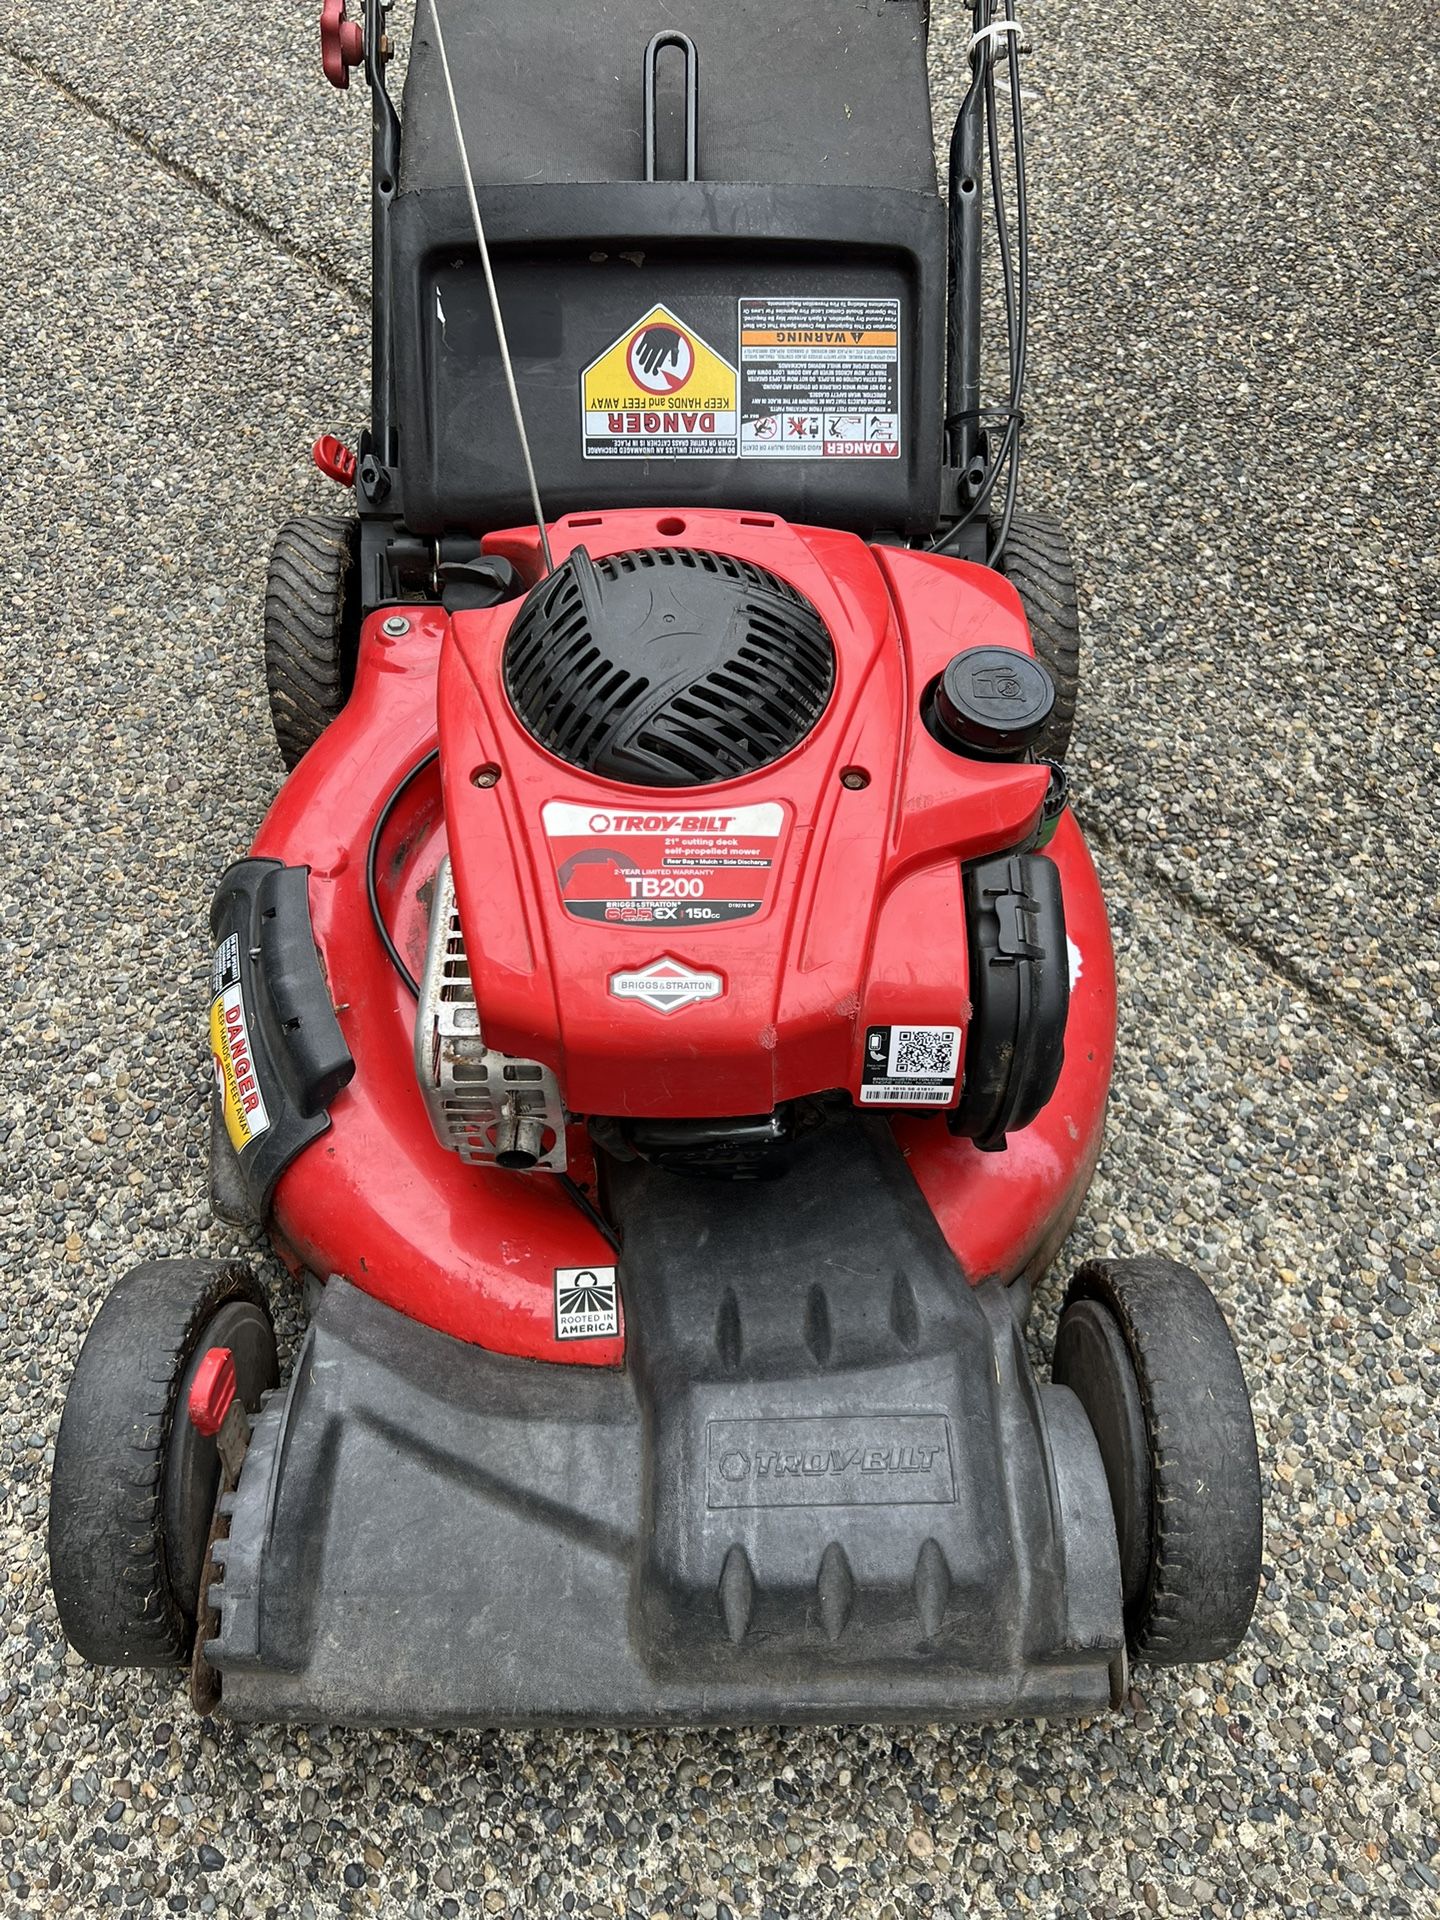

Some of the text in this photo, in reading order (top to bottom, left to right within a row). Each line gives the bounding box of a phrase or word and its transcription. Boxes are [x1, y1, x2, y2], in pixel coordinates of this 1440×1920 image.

[776, 332, 846, 343] WARNING
[591, 397, 729, 409] KEEP HANDS and FEET AWAY
[608, 412, 715, 433] DANGER
[612, 439, 735, 447] COVER OR ENTIRE GRASS CATCHER IS IN PLACE.
[827, 442, 881, 454] DANGER
[612, 816, 733, 832] TROY-BILT
[664, 838, 739, 847] 21" cutting deck
[664, 847, 760, 856] self-propelled mower
[682, 858, 695, 866] Bag
[641, 868, 671, 876] LIMITED
[625, 877, 704, 898] TB200
[216, 1002, 226, 1026] KEEP
[219, 1026, 229, 1062] HANDS
[225, 1004, 260, 1114] DANGER
[225, 1062, 234, 1079] and
[229, 1078, 241, 1105] FEET
[236, 1106, 251, 1137] AWAY
[560, 1313, 613, 1324] ROOTED IN
[561, 1322, 614, 1335] AMERICA
[755, 1446, 940, 1477] TROY-BILT
